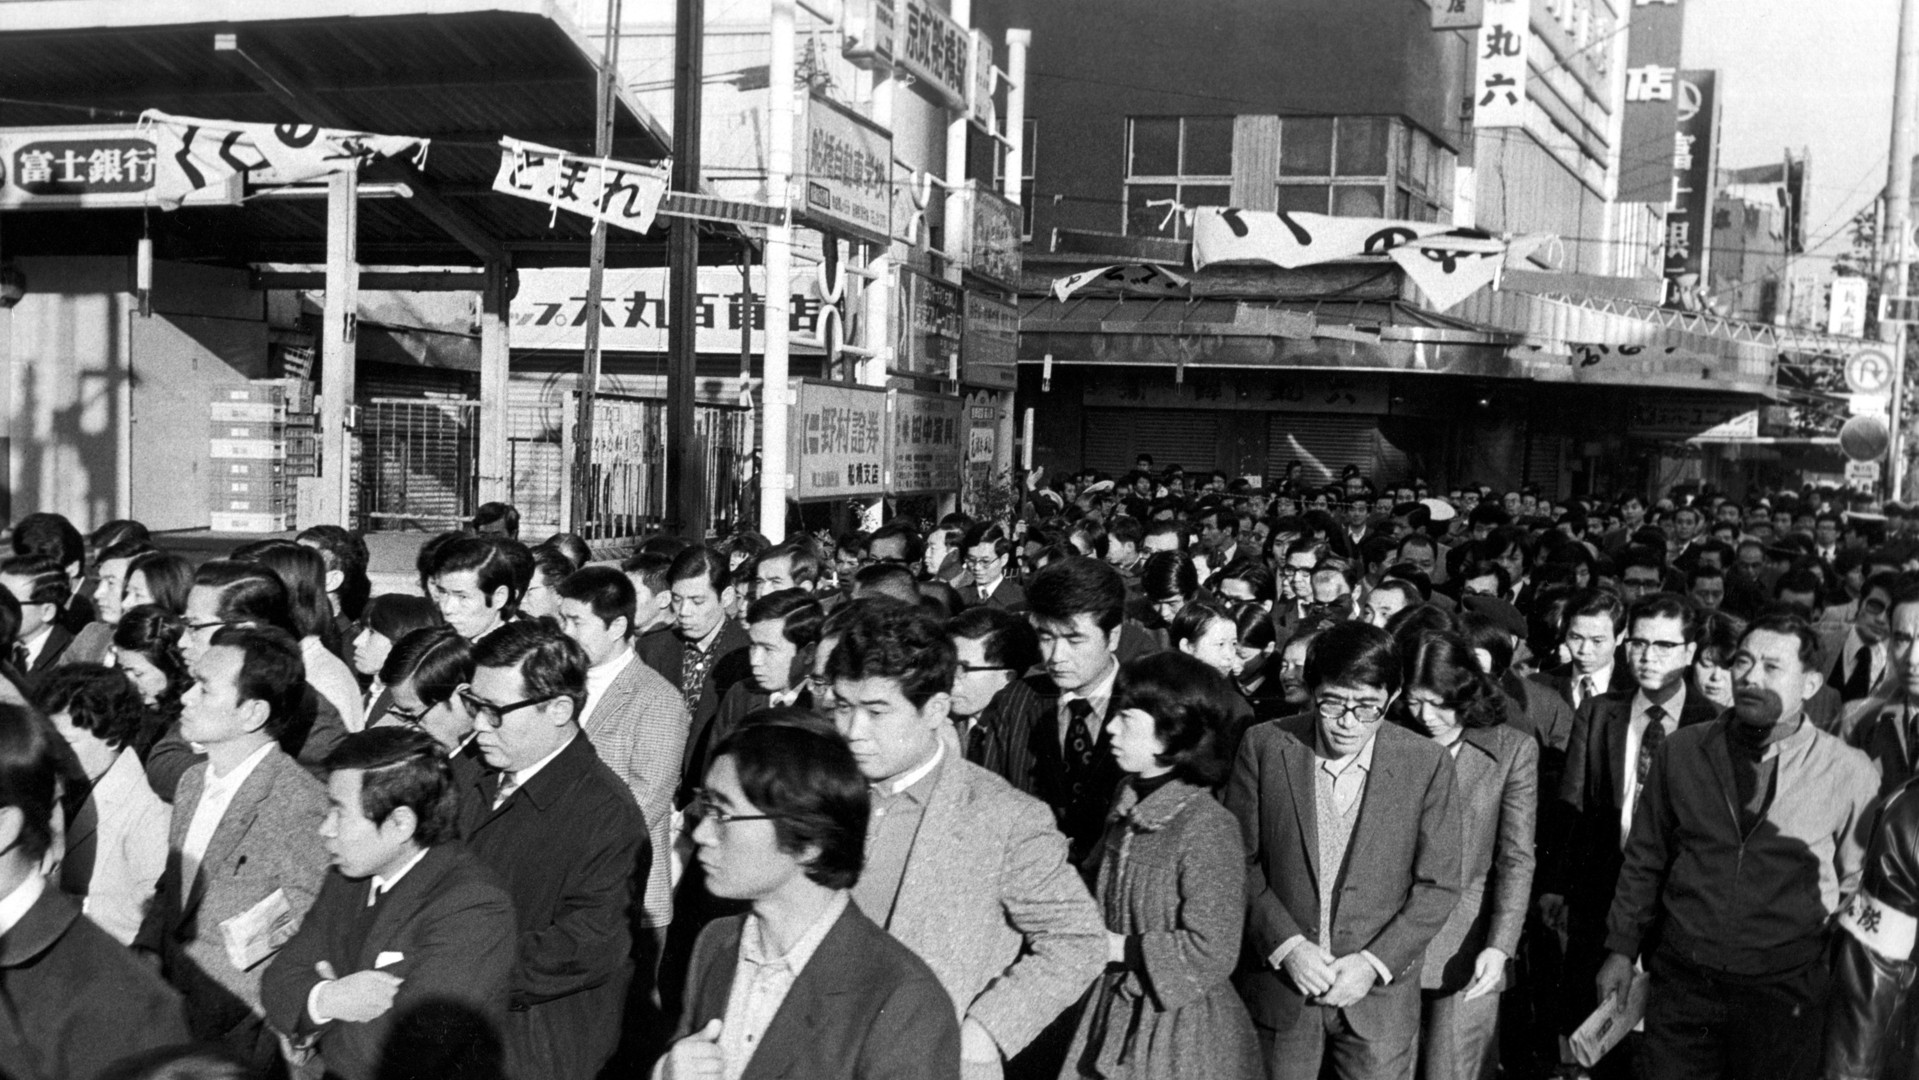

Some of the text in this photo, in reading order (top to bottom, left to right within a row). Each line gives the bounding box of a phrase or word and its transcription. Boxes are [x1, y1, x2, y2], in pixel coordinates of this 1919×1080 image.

[20, 148, 156, 184] 富士銀行
[509, 152, 641, 218] とまれ
